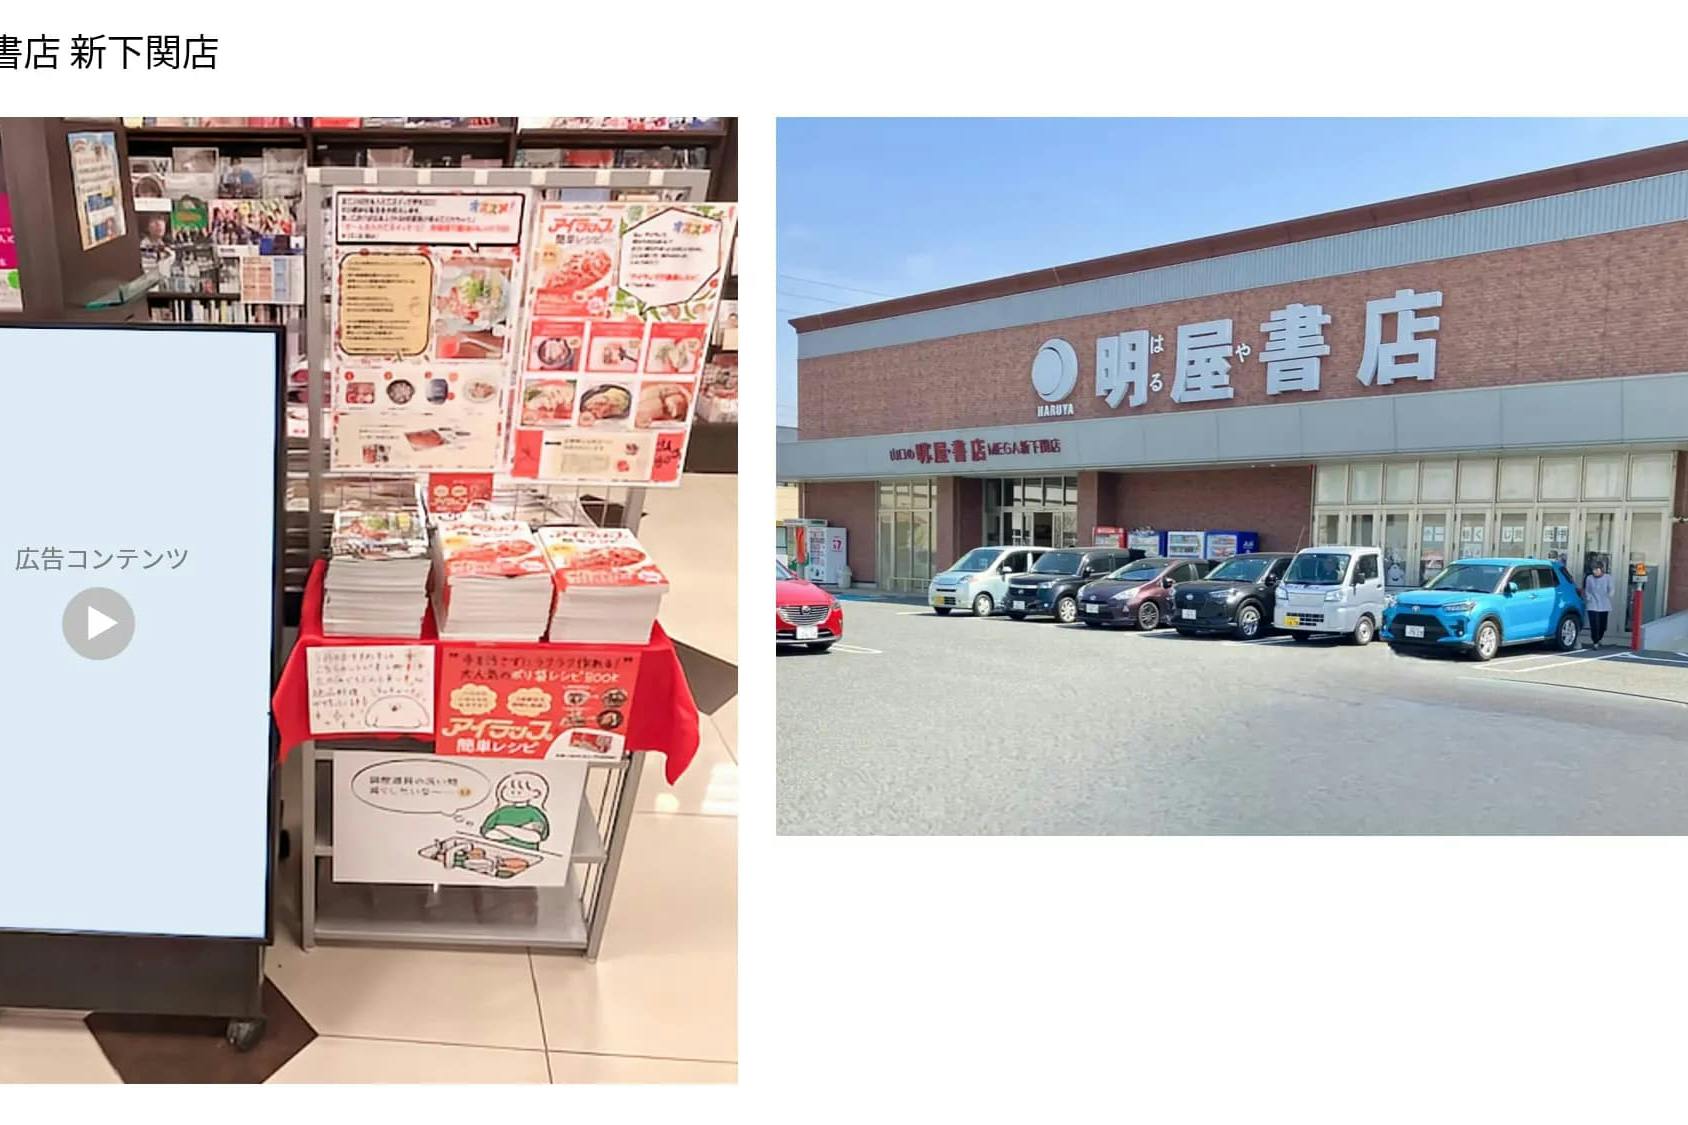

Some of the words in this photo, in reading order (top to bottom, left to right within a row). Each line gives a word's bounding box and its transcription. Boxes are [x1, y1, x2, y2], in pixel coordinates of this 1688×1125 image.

[1095, 288, 1444, 409] 明屋書店
[1036, 403, 1075, 417] HARUYA
[442, 716, 554, 742] アイラップ
[456, 737, 540, 755] 簡単レシピ
